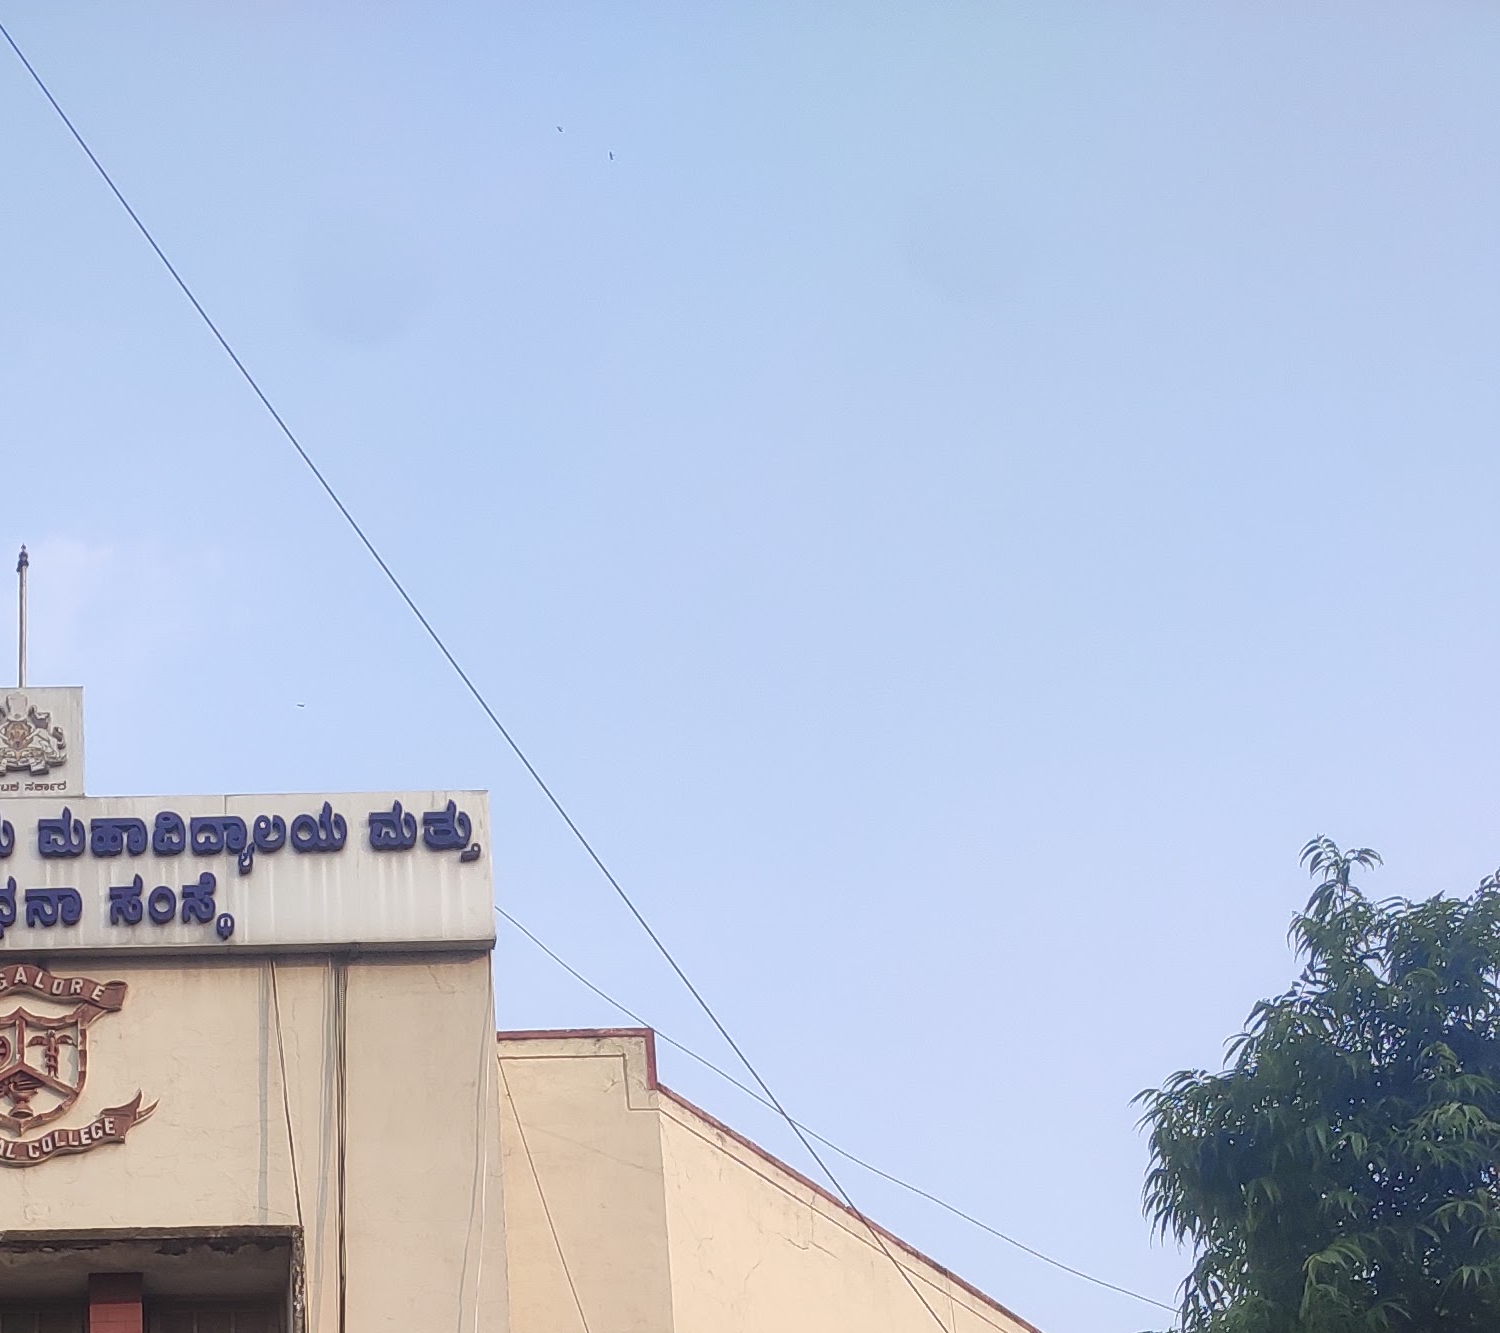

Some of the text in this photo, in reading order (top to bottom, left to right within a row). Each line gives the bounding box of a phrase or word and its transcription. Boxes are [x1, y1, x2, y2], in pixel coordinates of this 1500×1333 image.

[24, 780, 68, 792] ಸರ್ಕಾರ
[37, 800, 348, 876] ಮಹಾವಿದ್ಯಾಲಯ
[368, 799, 482, 863] ಮತ್ತು
[109, 871, 235, 941] ಸಂಸ್ಥೆ
[27, 1117, 117, 1159] COLLEGE
